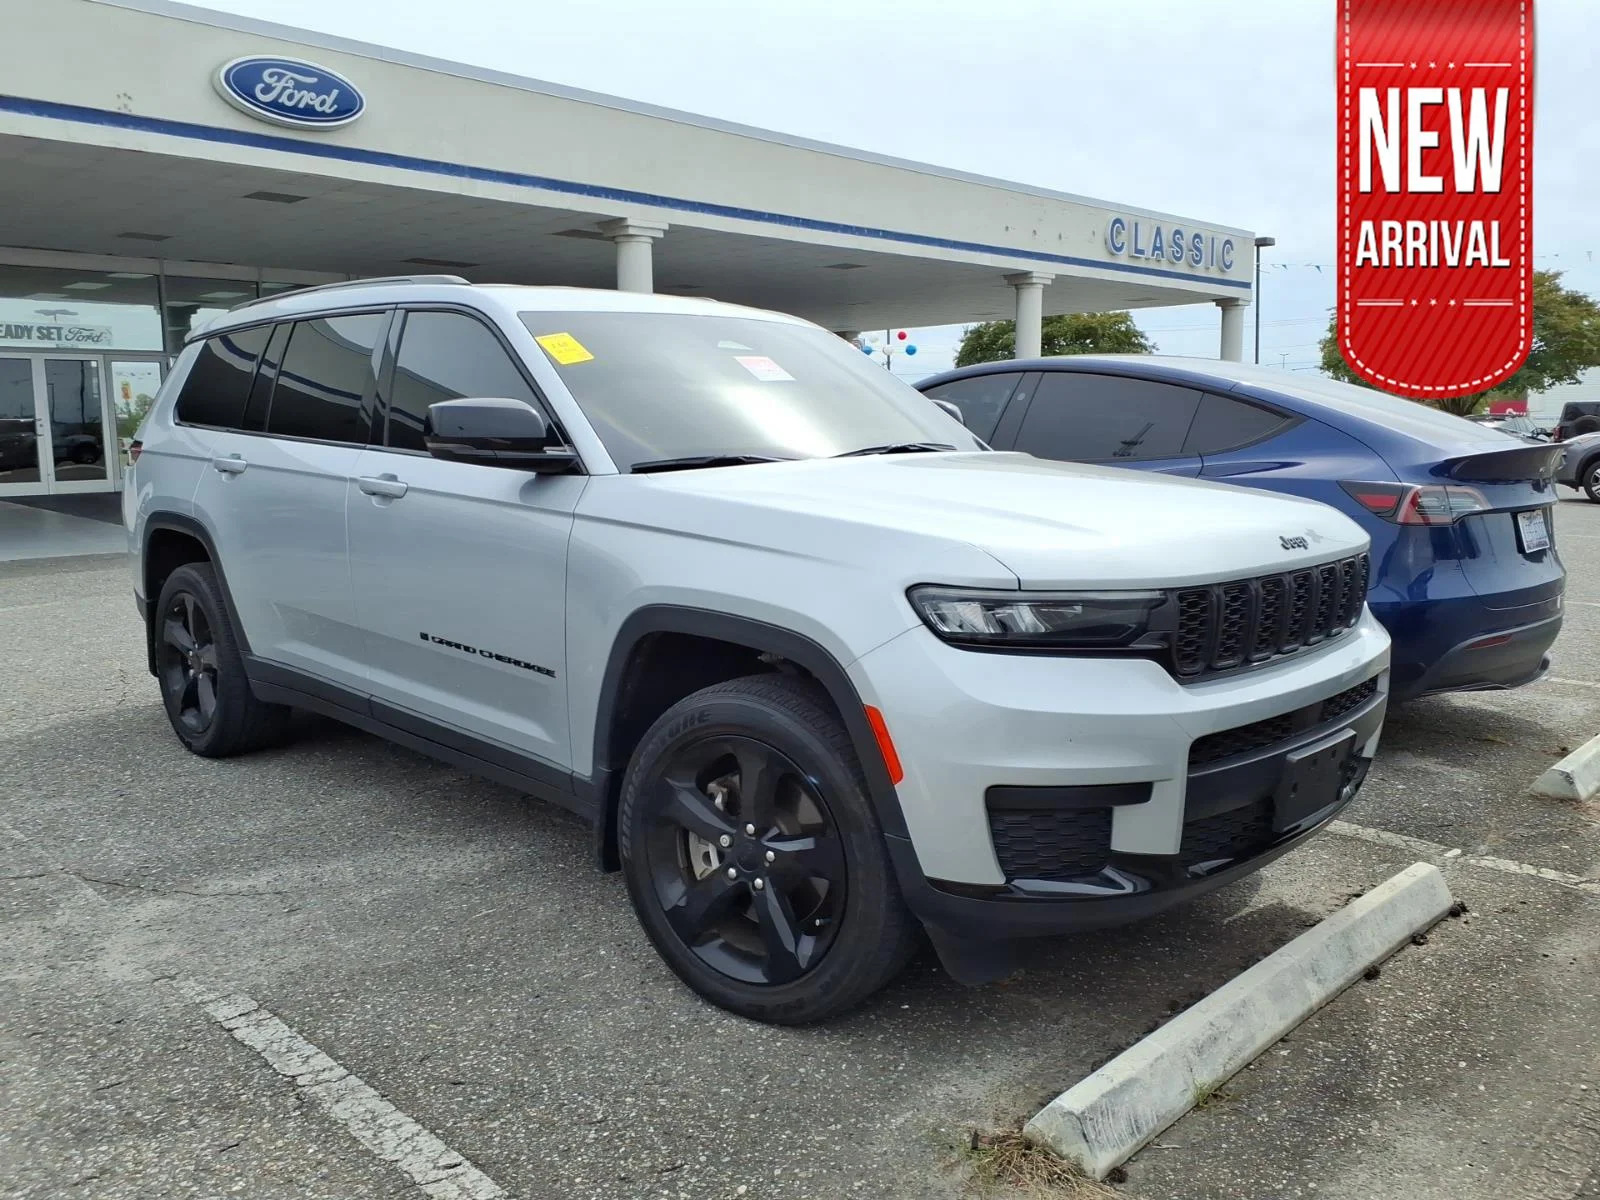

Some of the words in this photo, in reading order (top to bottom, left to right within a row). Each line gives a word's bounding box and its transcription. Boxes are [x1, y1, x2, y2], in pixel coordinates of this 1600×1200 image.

[254, 67, 340, 114] Ford
[1105, 216, 1235, 273] CLASSIC
[36, 325, 63, 341] SET
[64, 326, 106, 343] Ford
[1279, 535, 1309, 551] Jeep
[431, 635, 477, 654] GRAND
[479, 649, 557, 679] CHEROKEE
